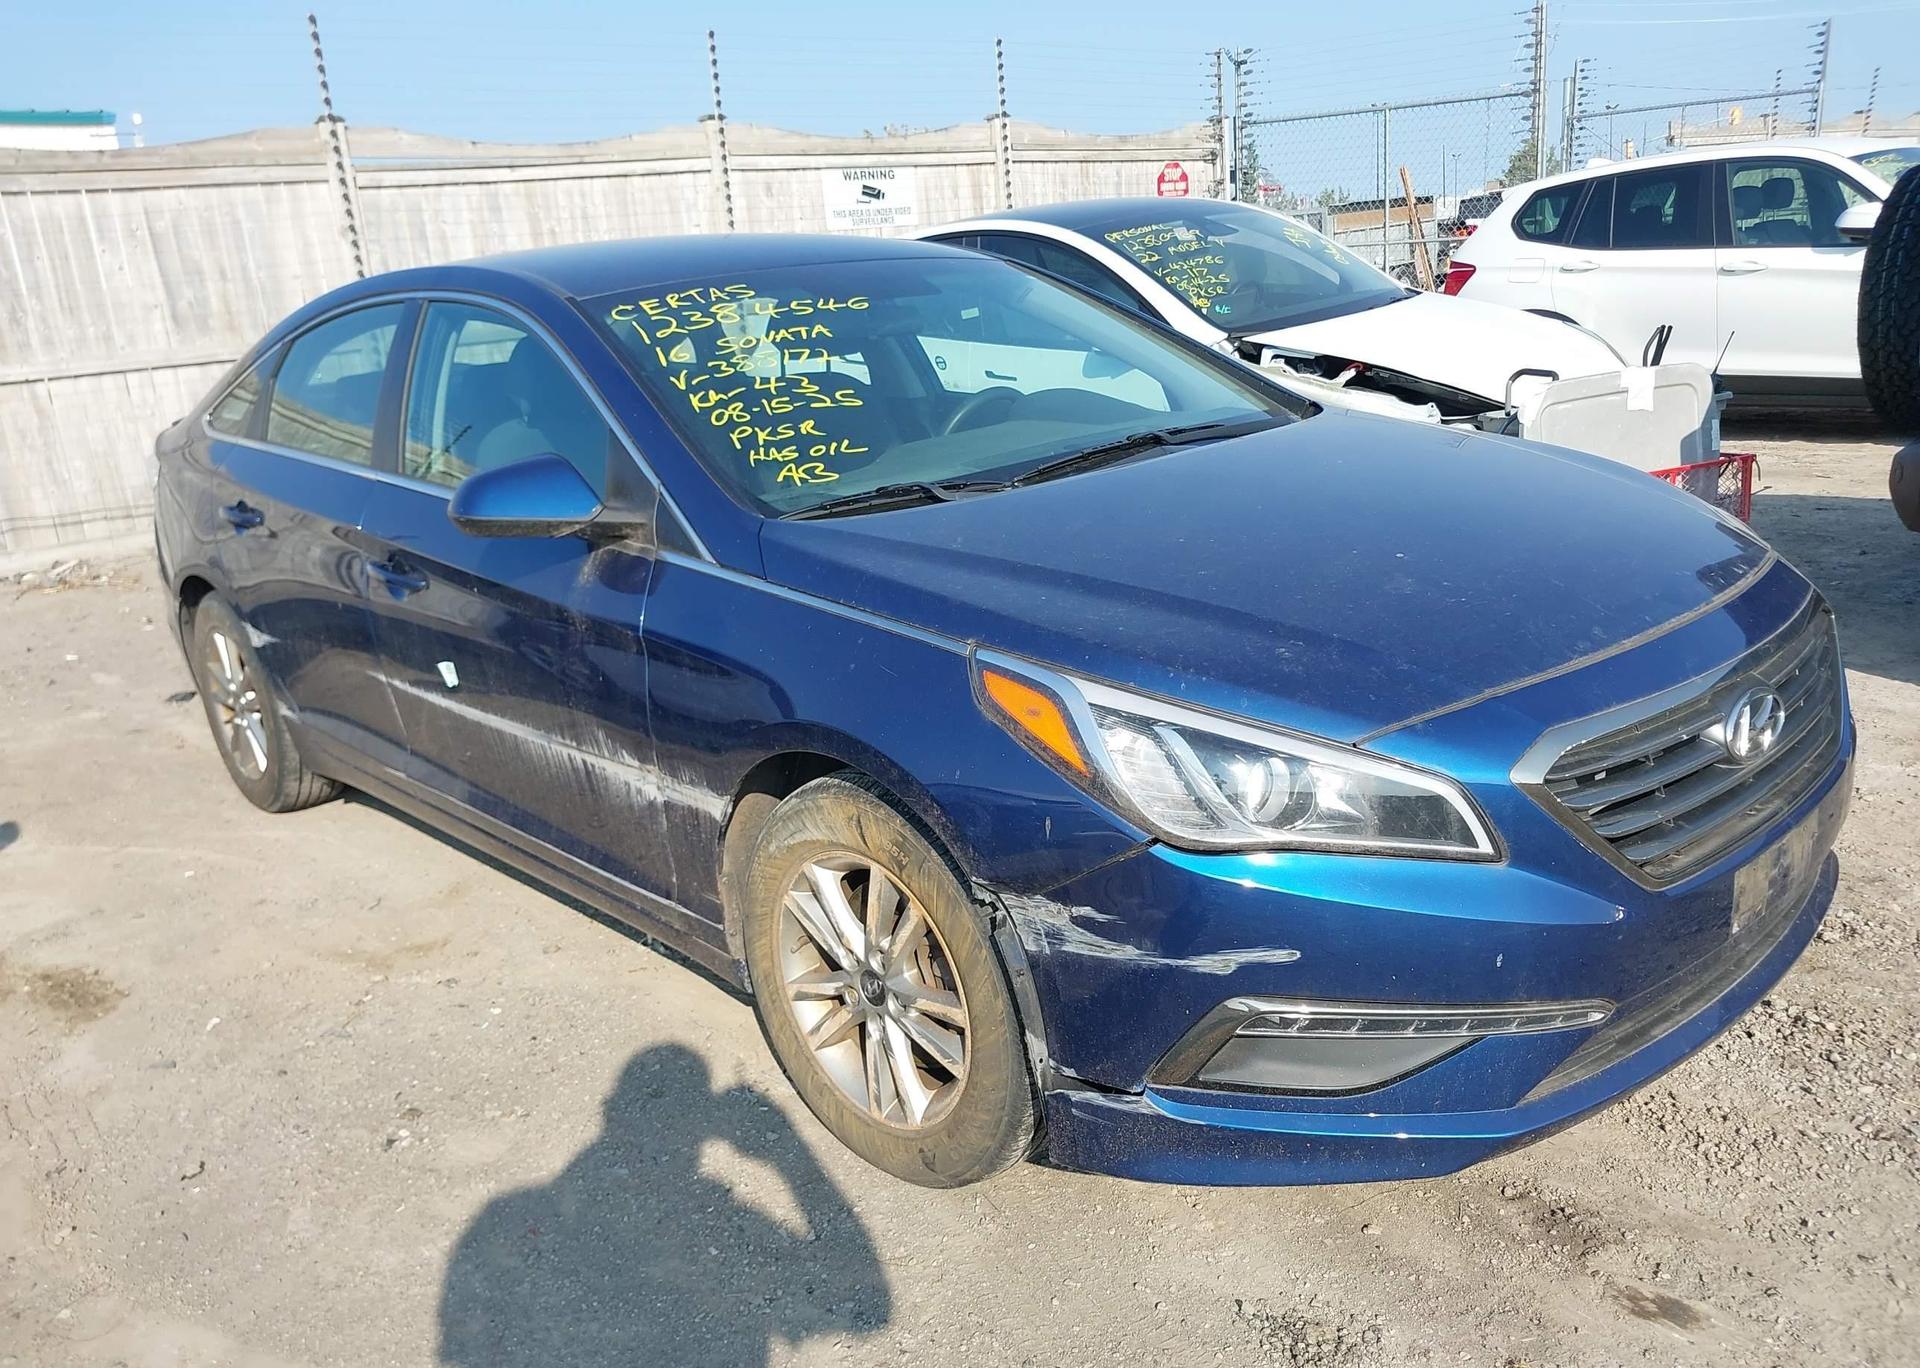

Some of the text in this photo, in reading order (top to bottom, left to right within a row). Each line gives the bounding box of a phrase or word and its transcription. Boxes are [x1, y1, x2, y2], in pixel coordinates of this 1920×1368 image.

[842, 170, 895, 181] WARNING
[1164, 168, 1182, 181] STOP
[833, 210, 846, 218] THIS
[872, 208, 893, 216] UNDER
[894, 207, 911, 215] VIDEO
[1104, 224, 1172, 242] PERSONAL
[1168, 241, 1212, 255] MODEL
[611, 284, 757, 321] CERTAS
[656, 323, 833, 367] 16 SONATA
[730, 419, 827, 450] PKSR
[749, 439, 869, 467] HAS OIL
